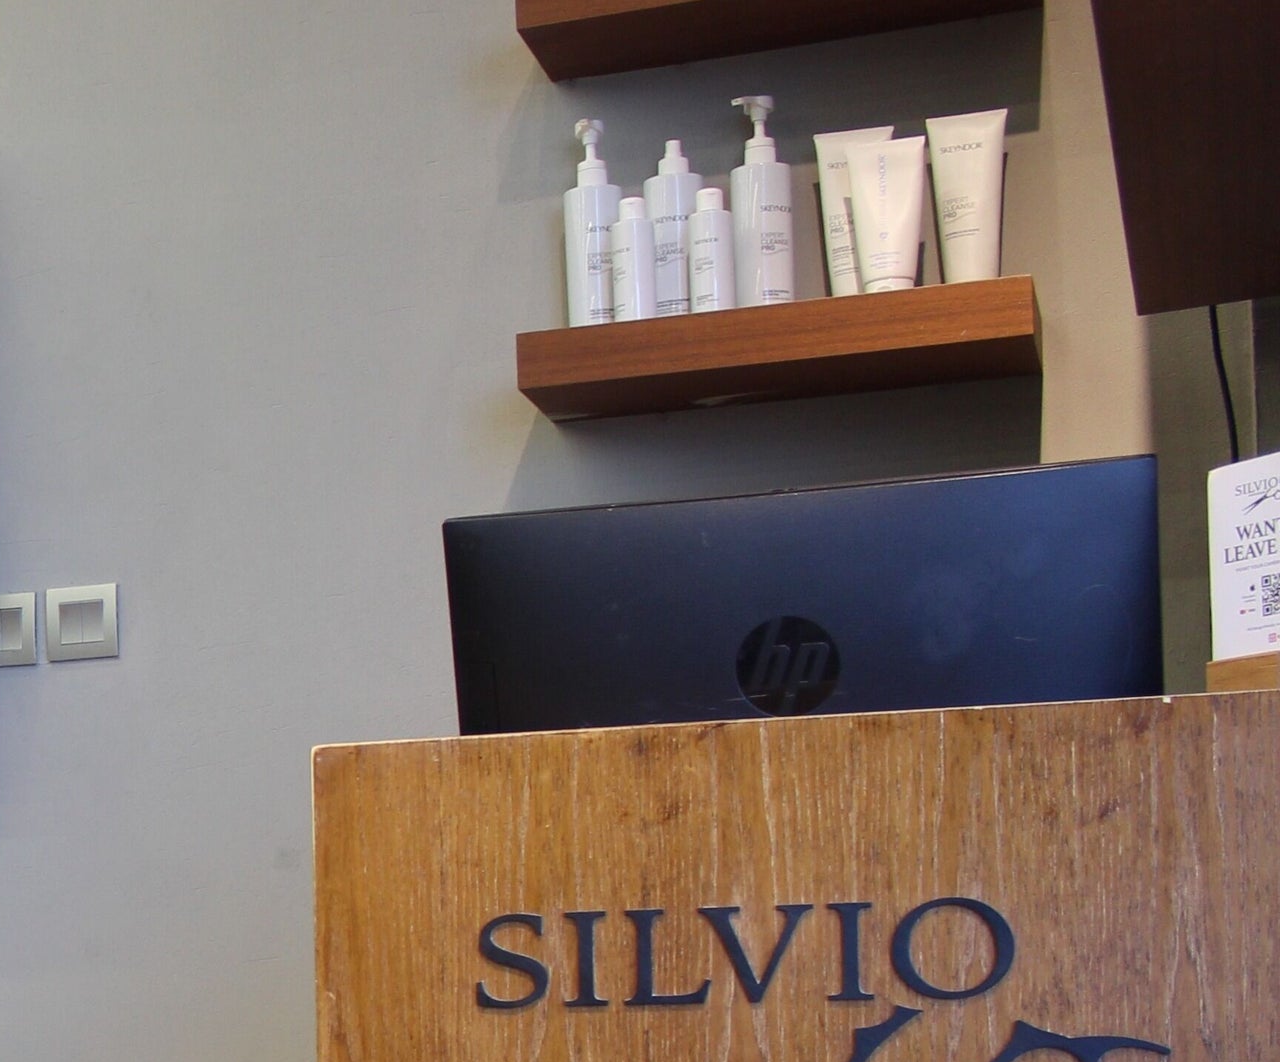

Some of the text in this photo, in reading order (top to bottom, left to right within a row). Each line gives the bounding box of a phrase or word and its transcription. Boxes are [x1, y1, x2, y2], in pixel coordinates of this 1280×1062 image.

[1234, 476, 1279, 497] SILVIO
[1224, 538, 1278, 564] LEAVE
[476, 897, 1016, 1008] SILVIO
